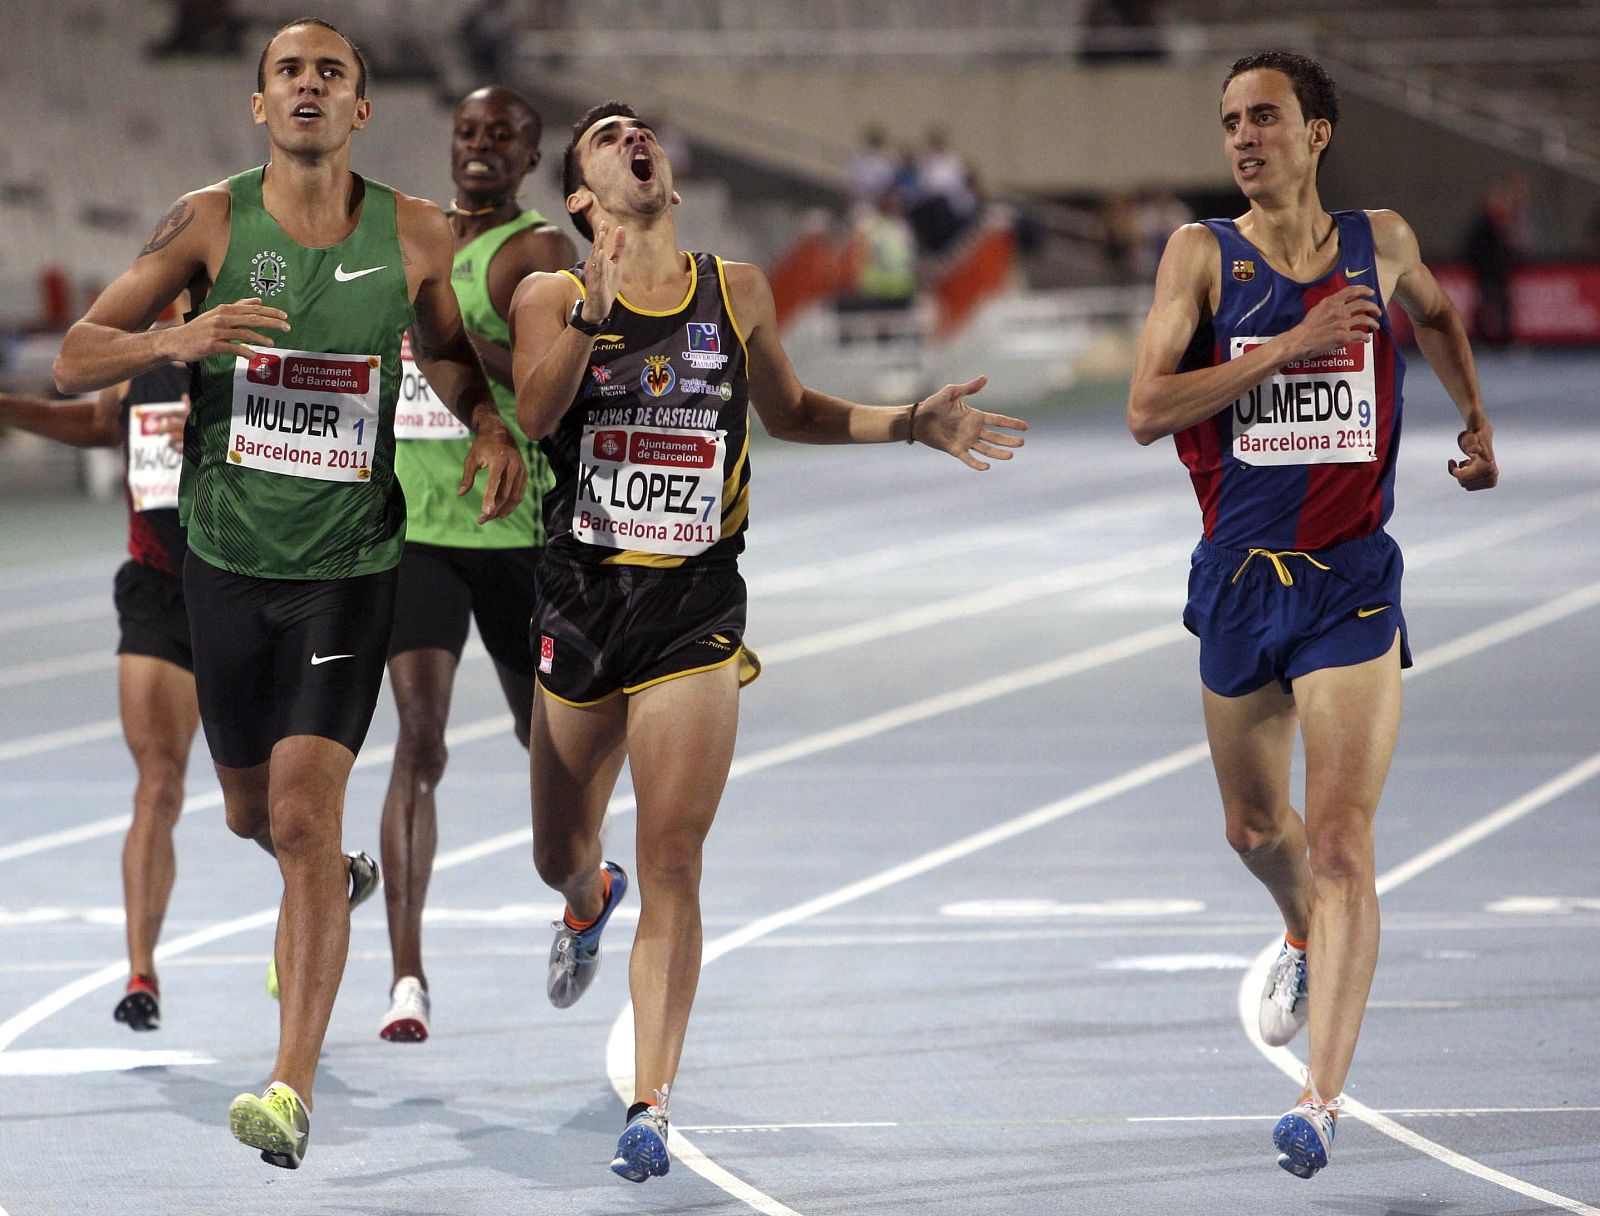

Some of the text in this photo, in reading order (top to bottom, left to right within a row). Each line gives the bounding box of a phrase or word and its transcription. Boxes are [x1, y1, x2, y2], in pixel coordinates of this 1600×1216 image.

[251, 250, 287, 268] OREGON
[250, 271, 263, 295] TRACK
[270, 275, 286, 297] CLUB
[291, 363, 352, 377] Ajuntament
[1288, 358, 1354, 369] de Barcelona
[290, 374, 358, 388] de Barcelona
[1235, 380, 1371, 428] OLMEDO 9
[245, 394, 340, 438] MULDER
[352, 418, 365, 446] 1
[588, 407, 718, 429] PLAYAS DE CASTELLON
[235, 434, 368, 469] Barcelona 2011
[638, 438, 698, 452] Ajuntament
[1239, 429, 1373, 452] Barcelona 2011
[637, 450, 704, 463] de Barcelona
[578, 463, 716, 523] K. LOPEZ 7
[579, 510, 715, 544] Barcelona 2011
